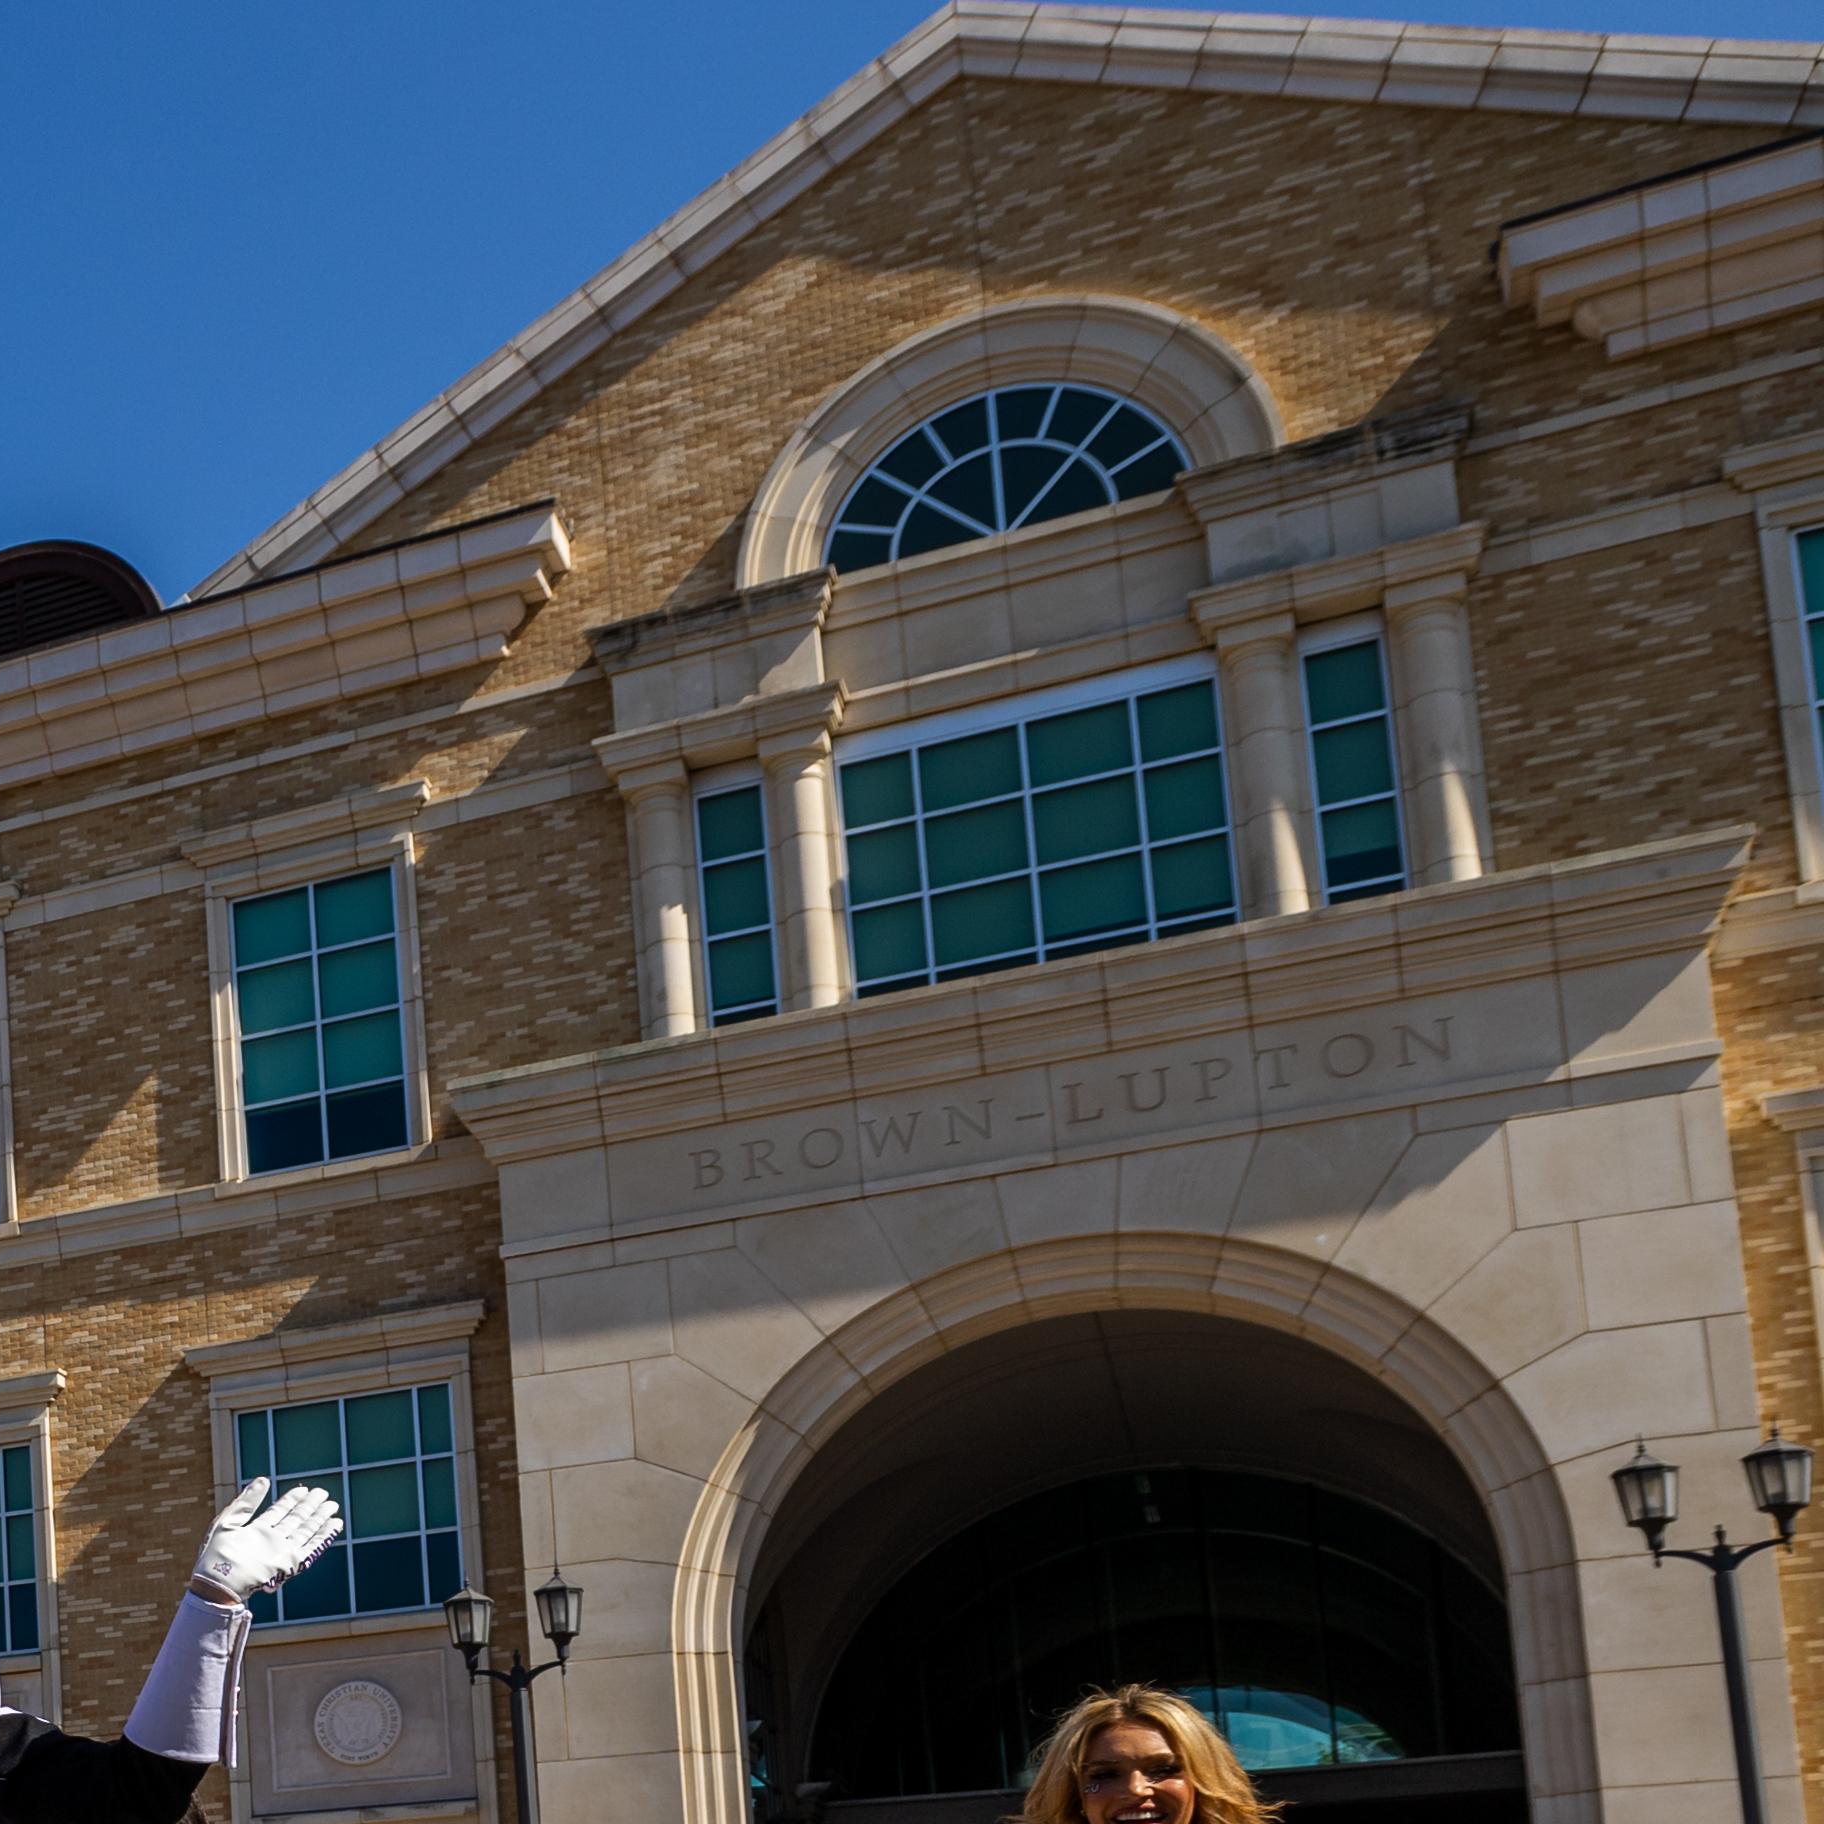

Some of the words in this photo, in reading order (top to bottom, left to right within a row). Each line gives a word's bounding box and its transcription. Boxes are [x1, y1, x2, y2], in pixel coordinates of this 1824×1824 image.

[687, 1016, 1456, 1192] BROWN-LUPTON
[318, 1683, 369, 1718] CHRISTIAN
[372, 1686, 399, 1750] UNIVERSITY
[317, 1721, 336, 1754] TEXAS
